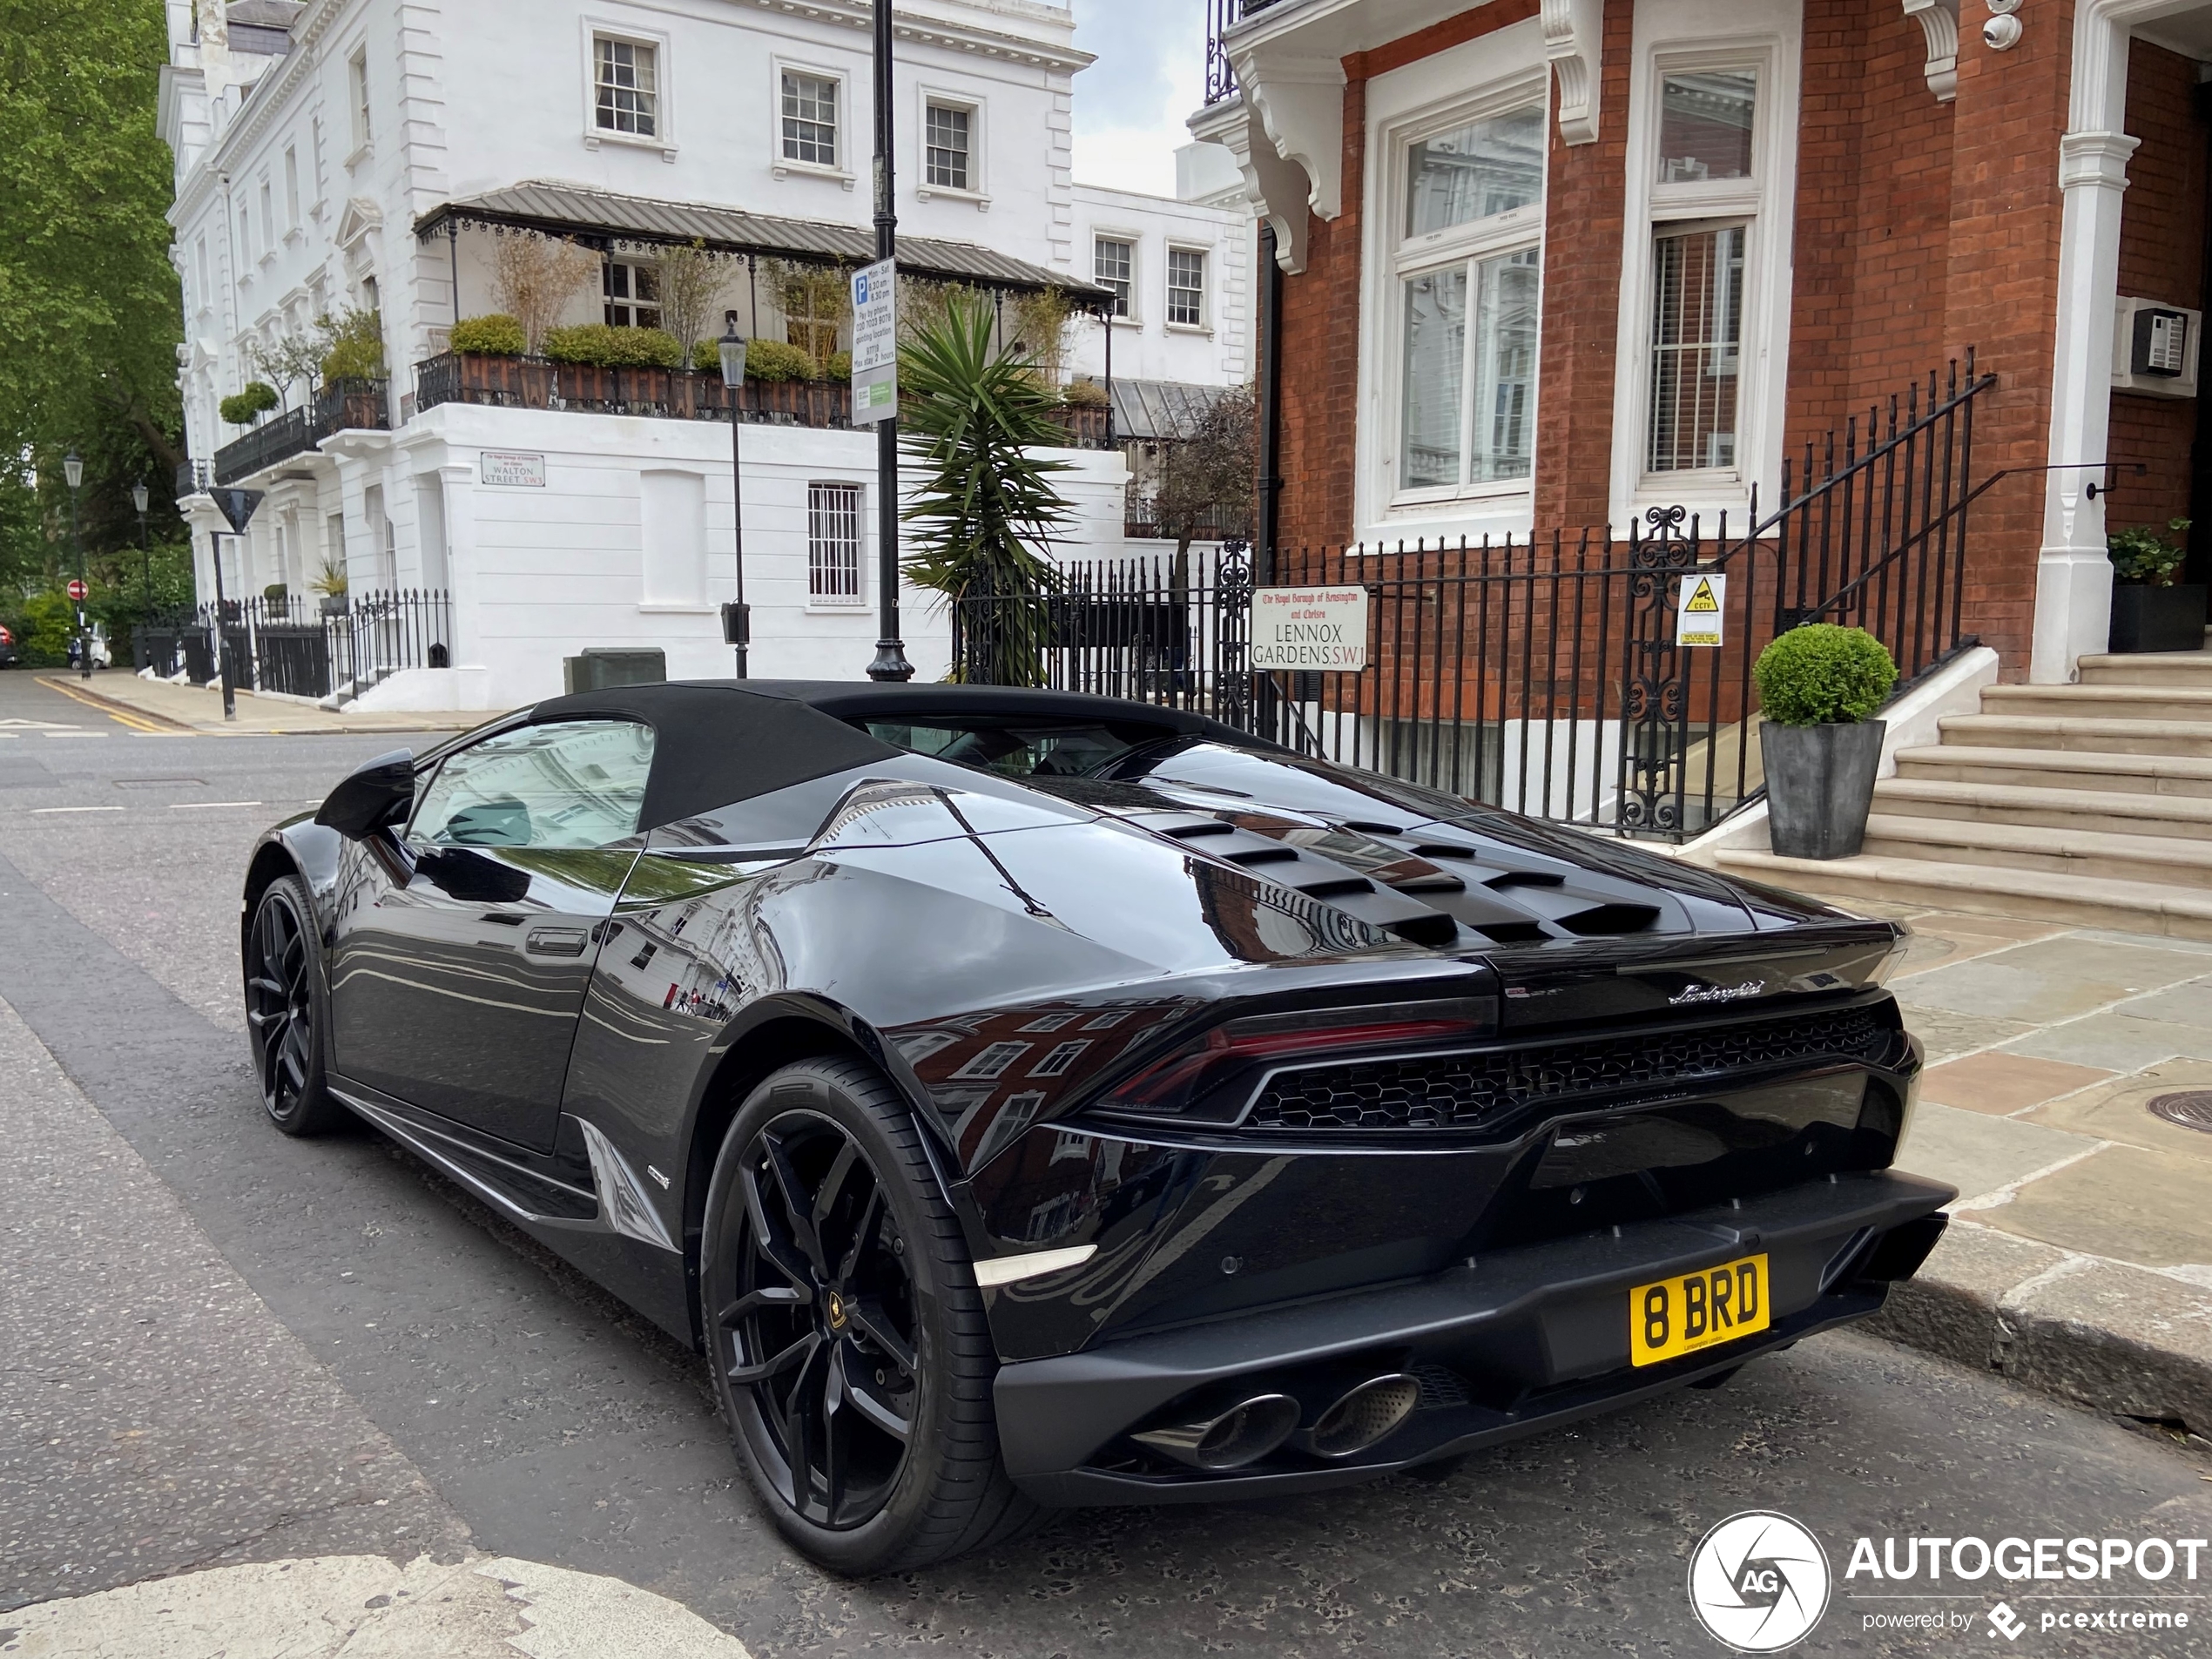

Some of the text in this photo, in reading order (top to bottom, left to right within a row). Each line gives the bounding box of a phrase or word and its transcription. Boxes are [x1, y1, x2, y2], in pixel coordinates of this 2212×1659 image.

[867, 309, 873, 318] by
[874, 306, 887, 317] phone
[873, 327, 891, 339] location
[854, 360, 863, 368] Max
[864, 357, 873, 366] stay
[881, 351, 894, 361] hours
[494, 467, 533, 475] WALTON
[485, 475, 520, 483] STREET
[1263, 591, 1358, 606] The Royal Borough of Kensington
[1291, 609, 1325, 619] and Chelsea
[1276, 624, 1342, 643] LENNOX
[1644, 1262, 1758, 1349] 8 BRD
